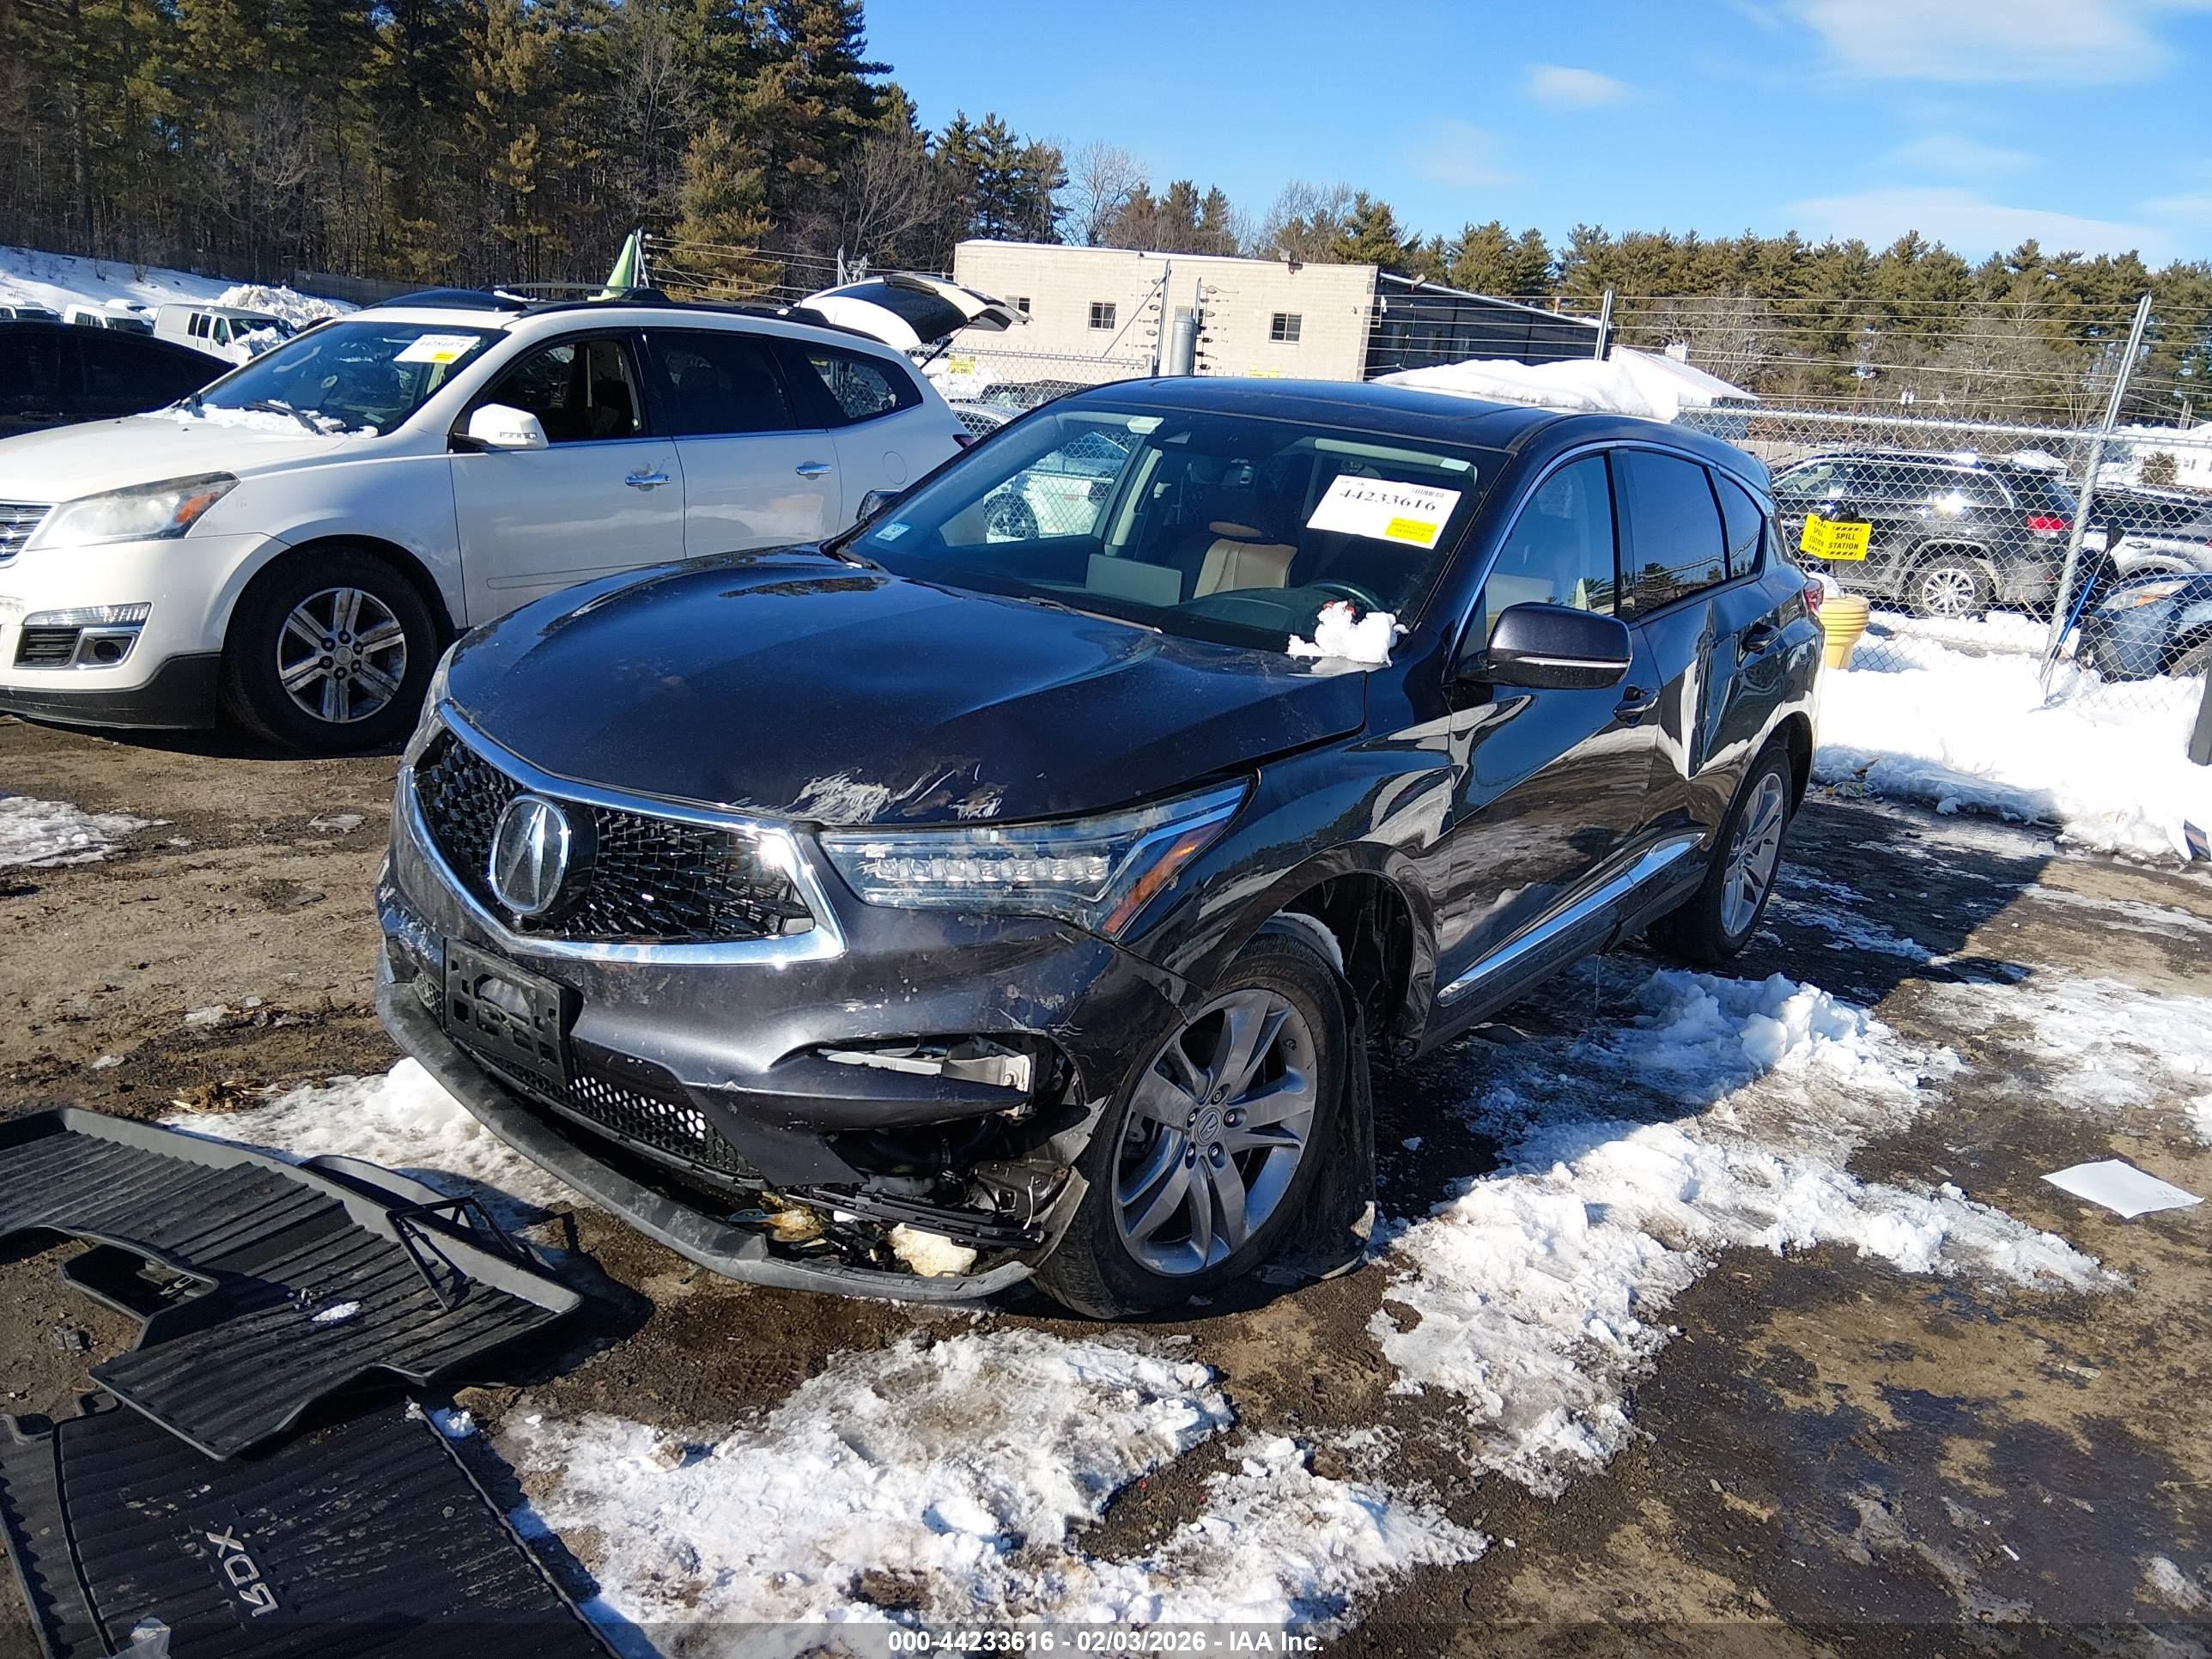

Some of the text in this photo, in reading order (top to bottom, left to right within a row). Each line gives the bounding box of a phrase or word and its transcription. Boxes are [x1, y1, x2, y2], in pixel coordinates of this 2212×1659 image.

[1339, 489, 1437, 512] 44233616
[1814, 526, 1823, 537] SPILL
[1809, 535, 1824, 547] STATION
[206, 1525, 279, 1618] RDX
